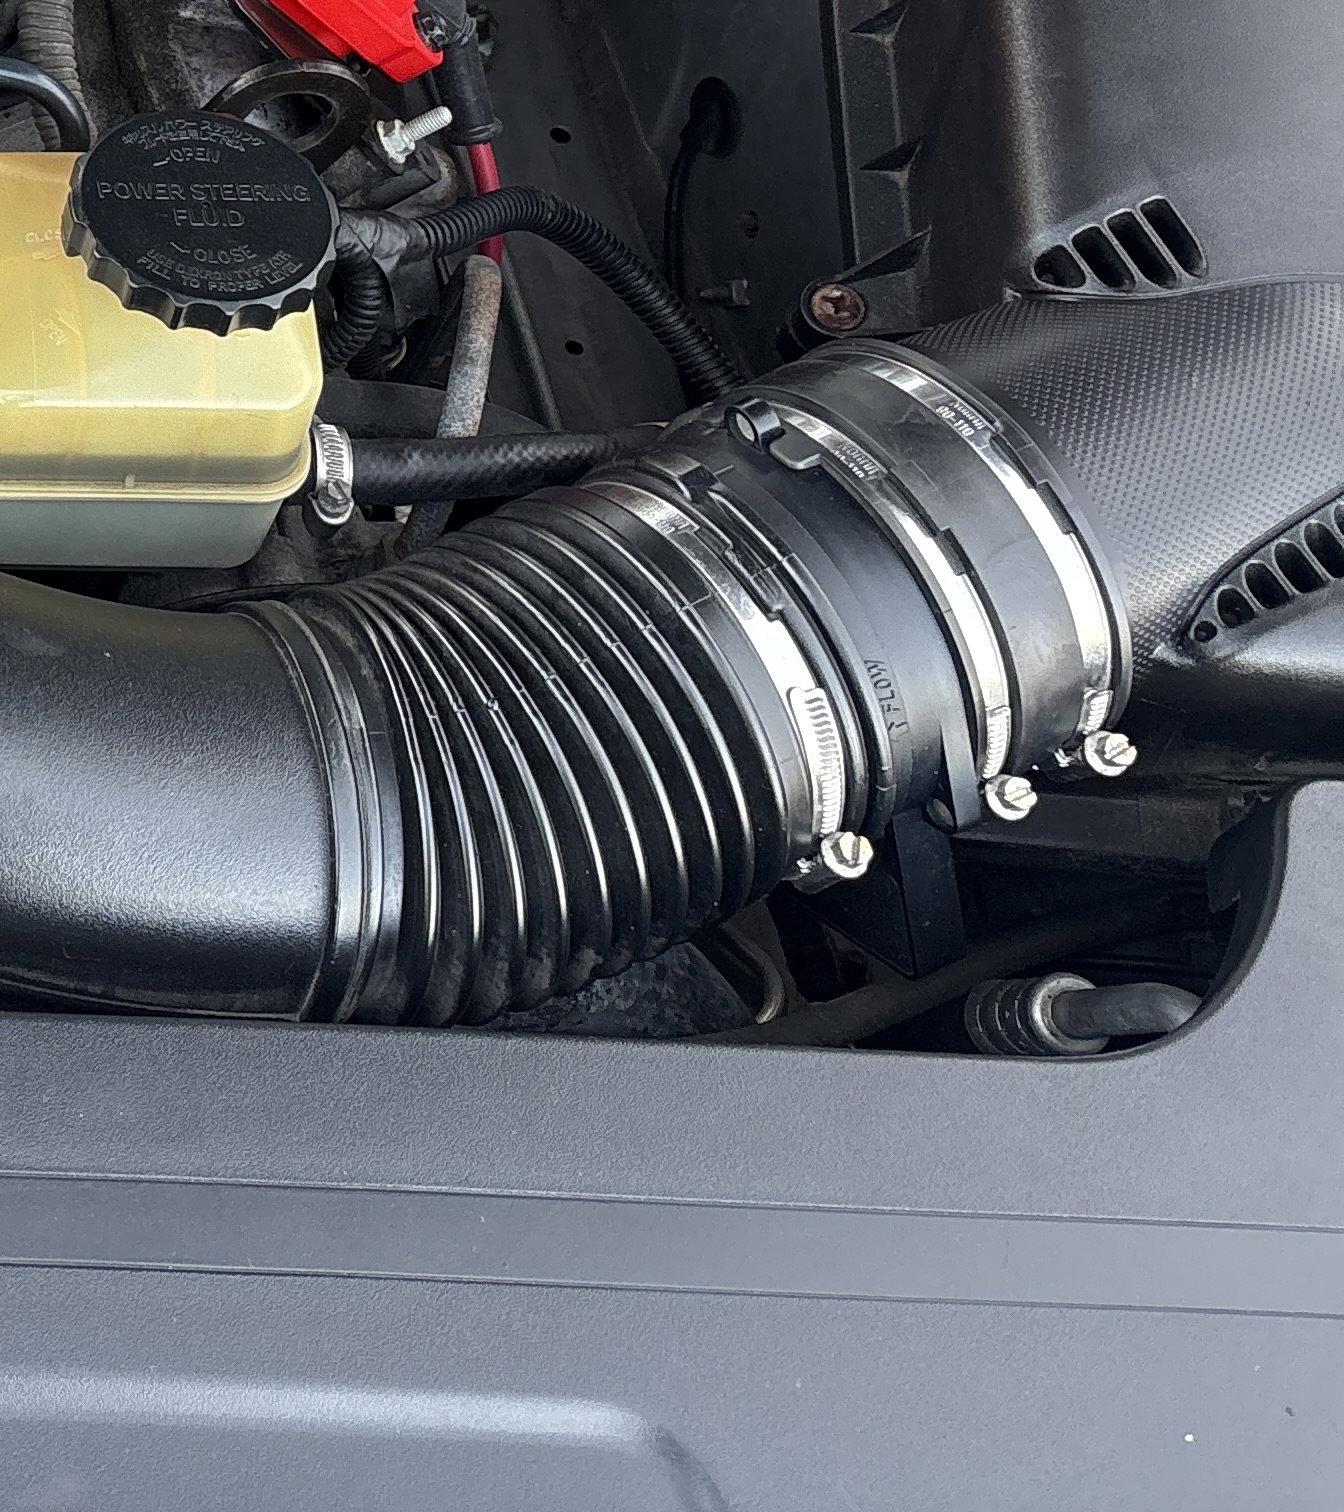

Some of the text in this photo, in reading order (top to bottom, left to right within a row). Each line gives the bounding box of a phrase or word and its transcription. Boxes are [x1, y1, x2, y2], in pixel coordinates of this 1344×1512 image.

[167, 147, 221, 164] OPEN
[96, 180, 311, 203] POWER STEERING
[172, 208, 245, 228] FLUID
[193, 244, 257, 265] CLOSE
[863, 658, 901, 714] FLOW
